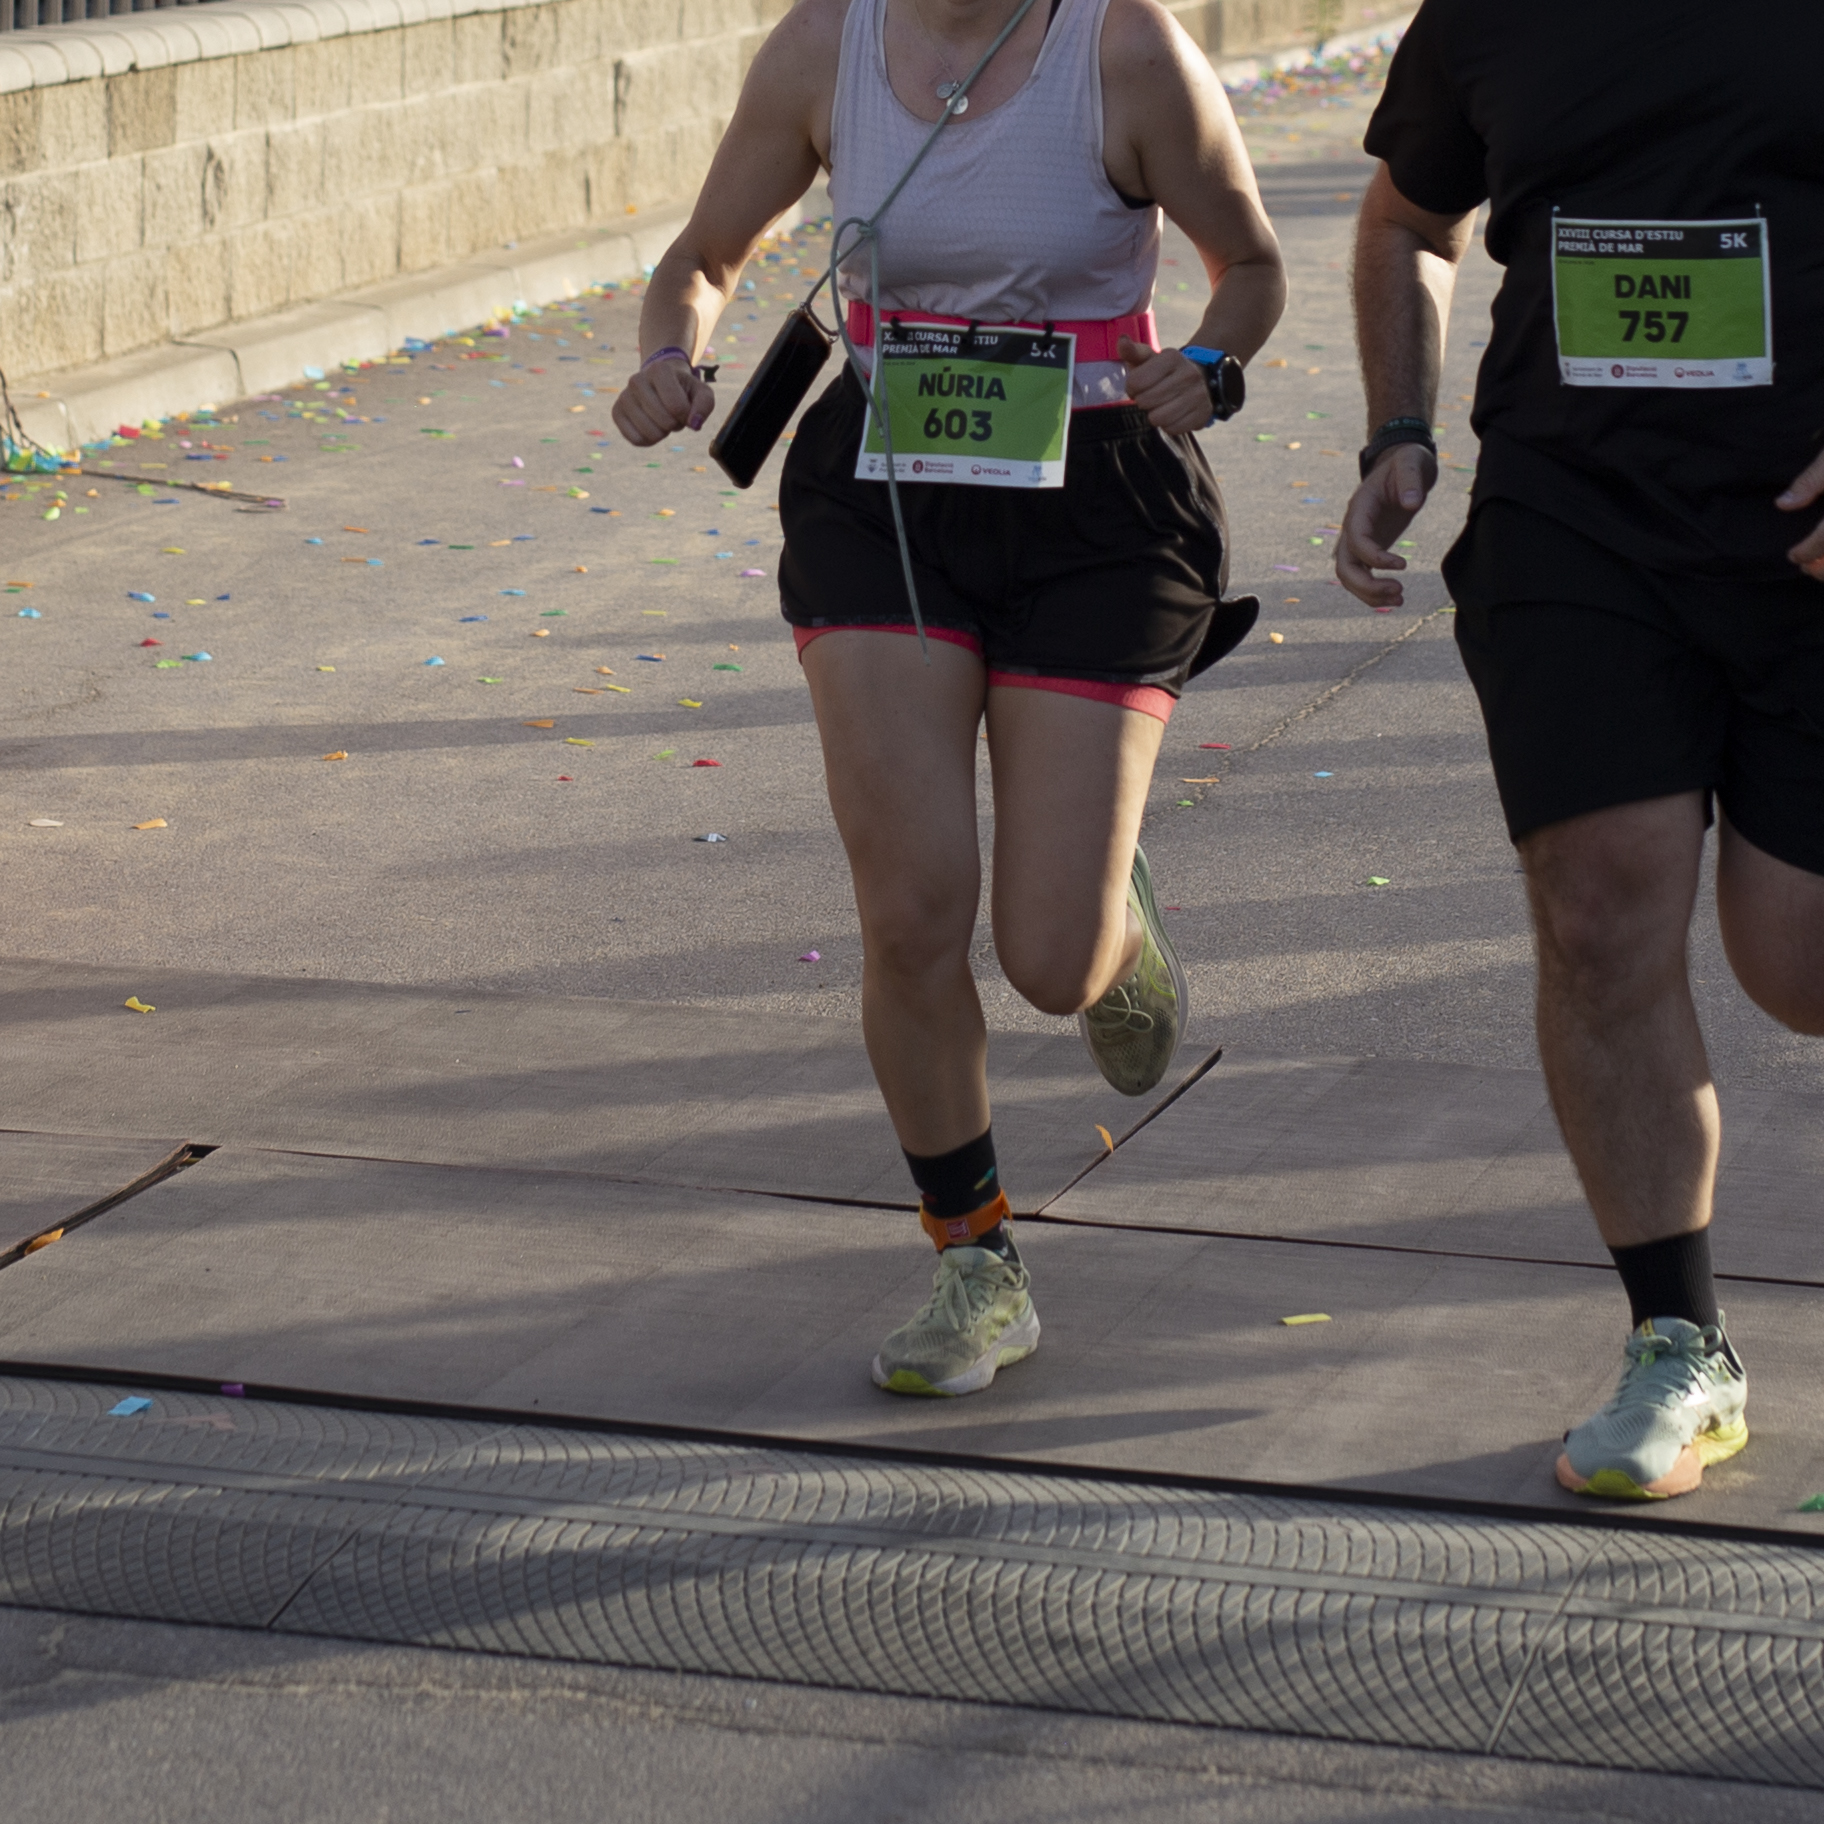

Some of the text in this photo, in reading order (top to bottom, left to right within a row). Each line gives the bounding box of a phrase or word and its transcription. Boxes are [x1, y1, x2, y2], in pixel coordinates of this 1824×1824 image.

[1592, 229, 1632, 241] CURSA
[1634, 229, 1684, 242] D'ESTIU
[1720, 232, 1748, 249] 5K
[1558, 239, 1645, 254] PREMIÀ DE MAR
[1614, 274, 1692, 300] DANI
[1618, 310, 1689, 343] 757
[932, 344, 959, 355] MAR
[917, 366, 1007, 401] NÚRIA
[923, 407, 992, 442] 603
